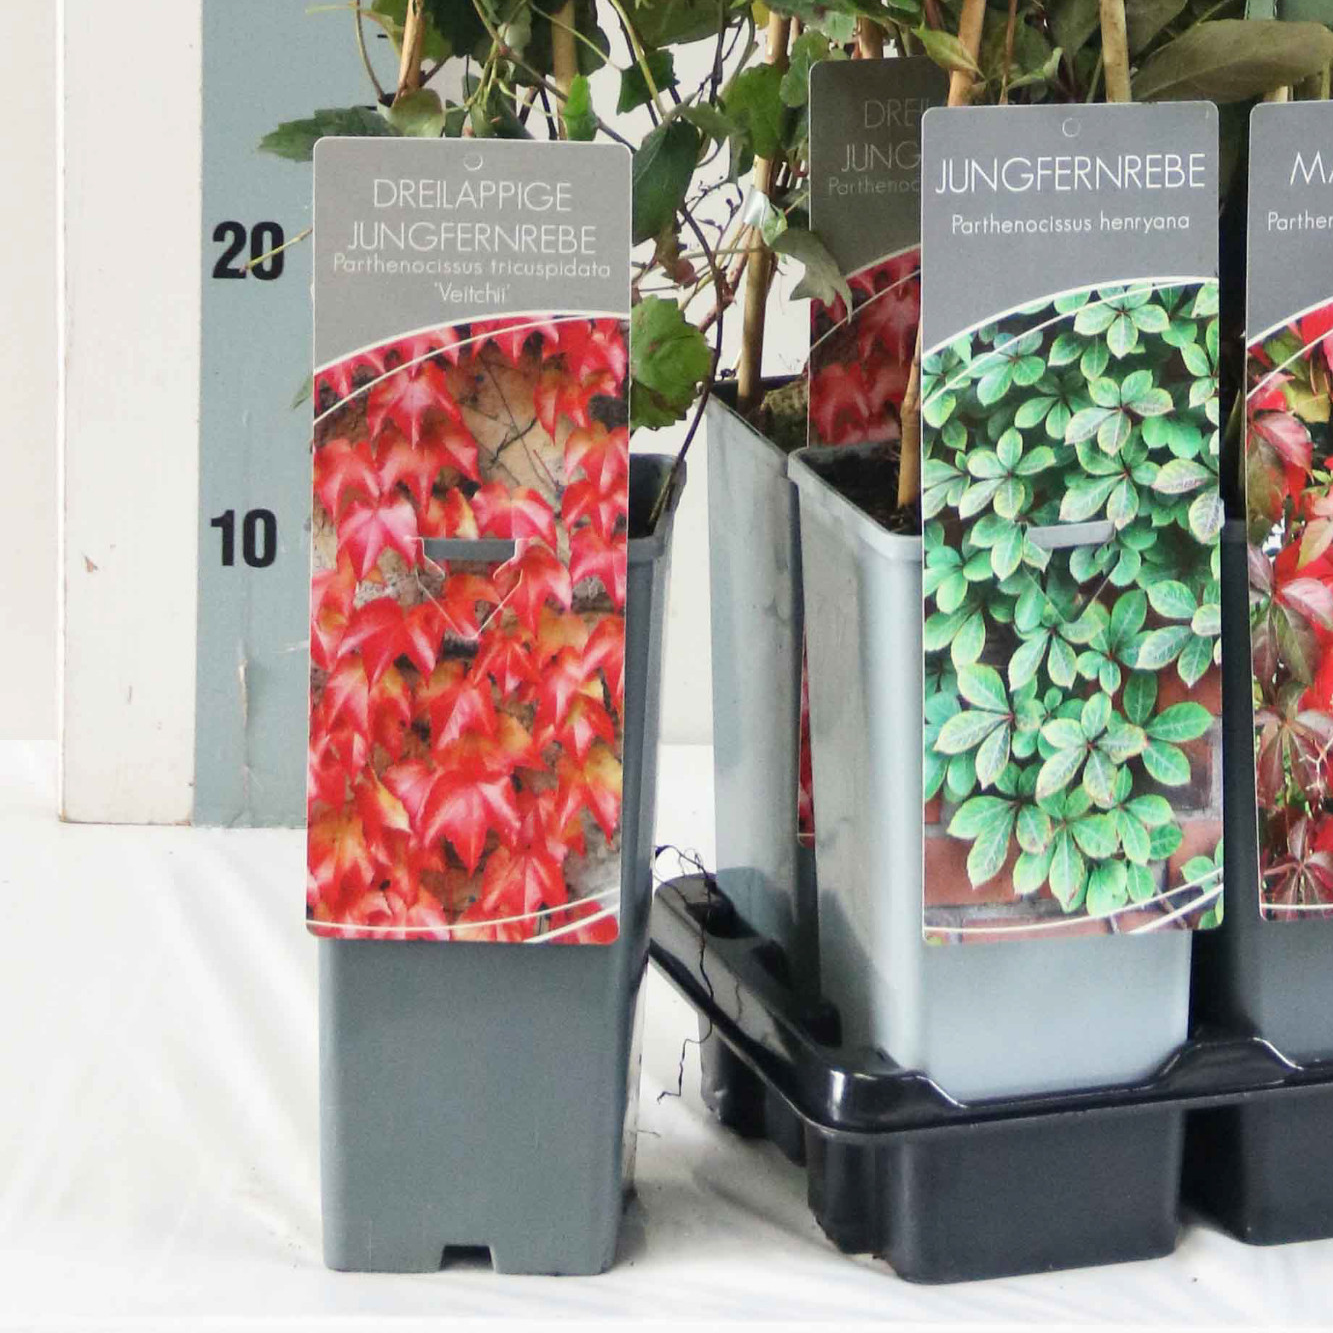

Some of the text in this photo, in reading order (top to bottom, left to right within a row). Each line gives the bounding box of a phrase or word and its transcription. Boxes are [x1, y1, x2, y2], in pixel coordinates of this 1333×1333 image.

[935, 153, 1206, 194] JUNGFERNREBE
[373, 178, 572, 212] DREILAPPIGE
[347, 221, 597, 254] JUNGFERNREBE
[951, 210, 1190, 234] Parthenocissus henryana
[213, 221, 285, 280] 20
[333, 252, 611, 279] Parthenocissus tricuspidata
[211, 509, 277, 567] 10
